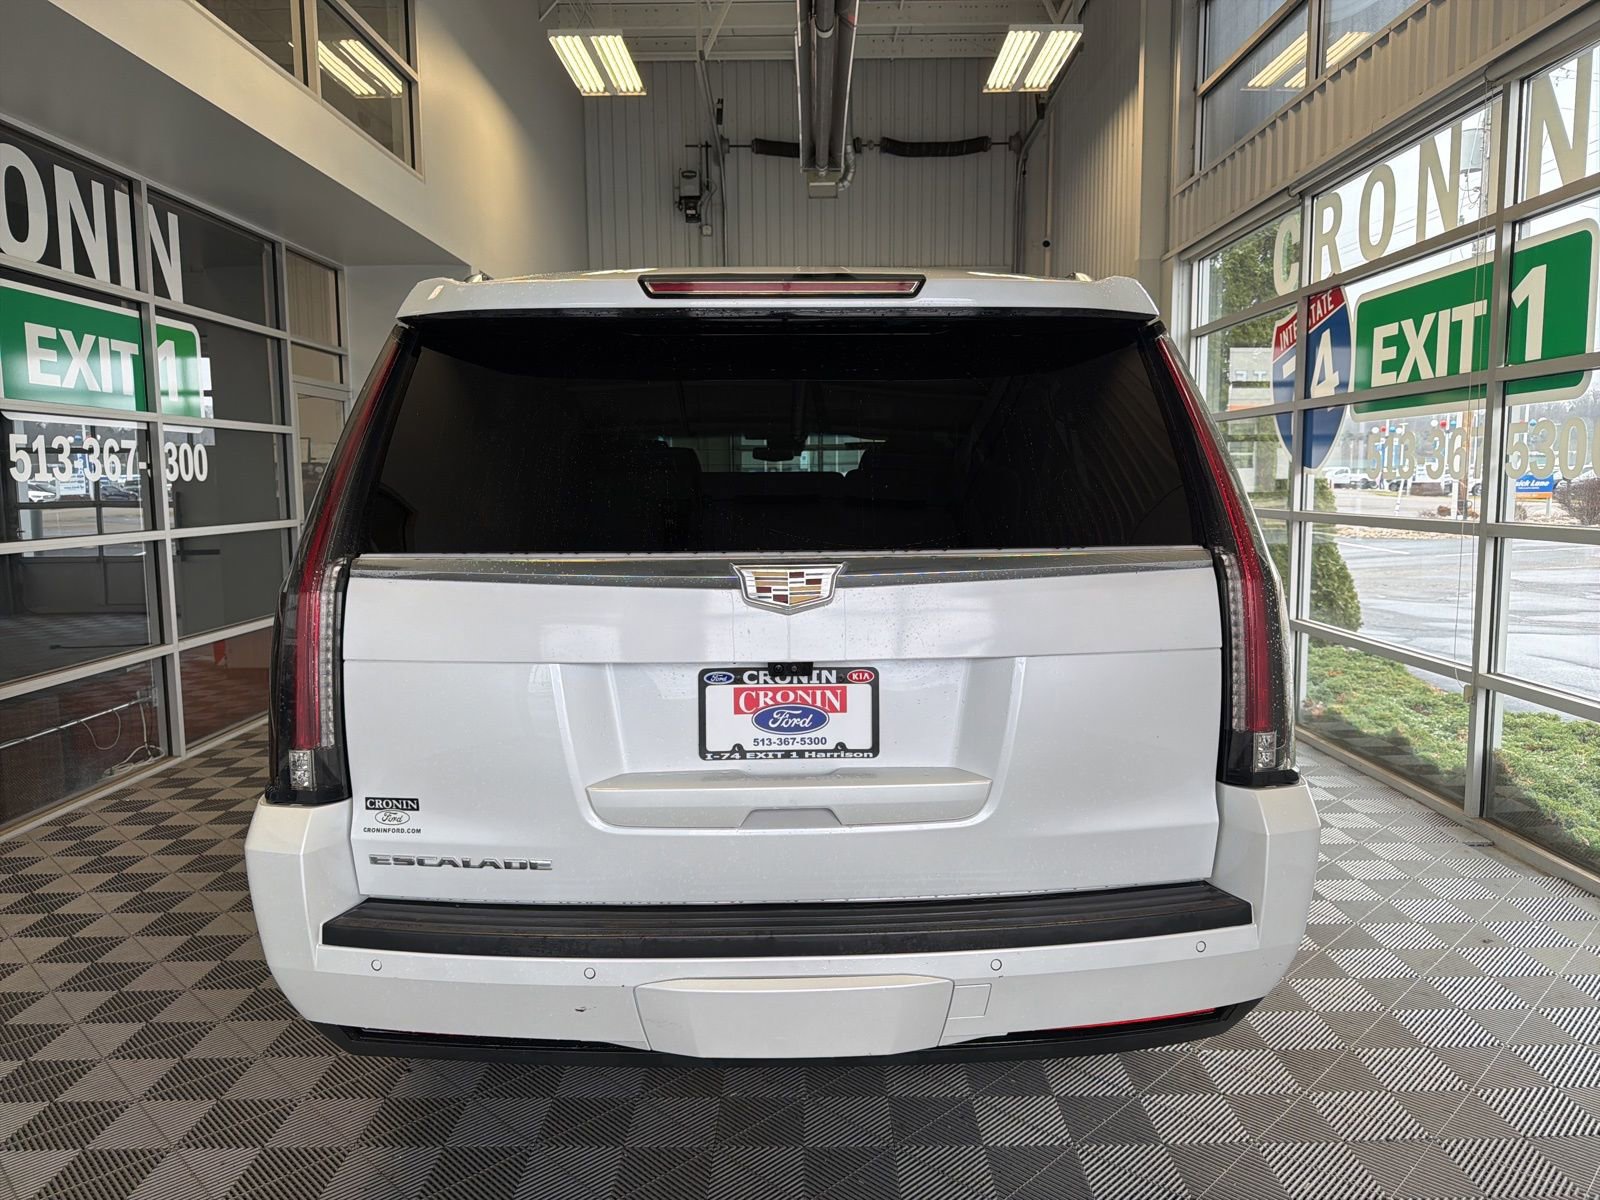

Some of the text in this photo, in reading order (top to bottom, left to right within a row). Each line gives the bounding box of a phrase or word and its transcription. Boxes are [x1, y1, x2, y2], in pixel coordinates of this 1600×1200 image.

[1370, 264, 1547, 388] EXIT 1
[24, 321, 179, 402] EXIT 1
[9, 433, 208, 482] 513-367-300
[707, 669, 870, 684] Ford CRONIN KIA
[738, 689, 842, 714] CRONIN
[768, 709, 813, 728] Ford
[753, 736, 827, 747] 513-367-5300
[705, 752, 742, 760] I-74
[746, 751, 785, 759] EXIT
[804, 751, 873, 759] Harrison
[366, 798, 418, 809] CRONIN
[381, 811, 404, 824] Ford
[363, 826, 422, 834] CRONINFORD.COM
[369, 854, 553, 871] ESCALADE
